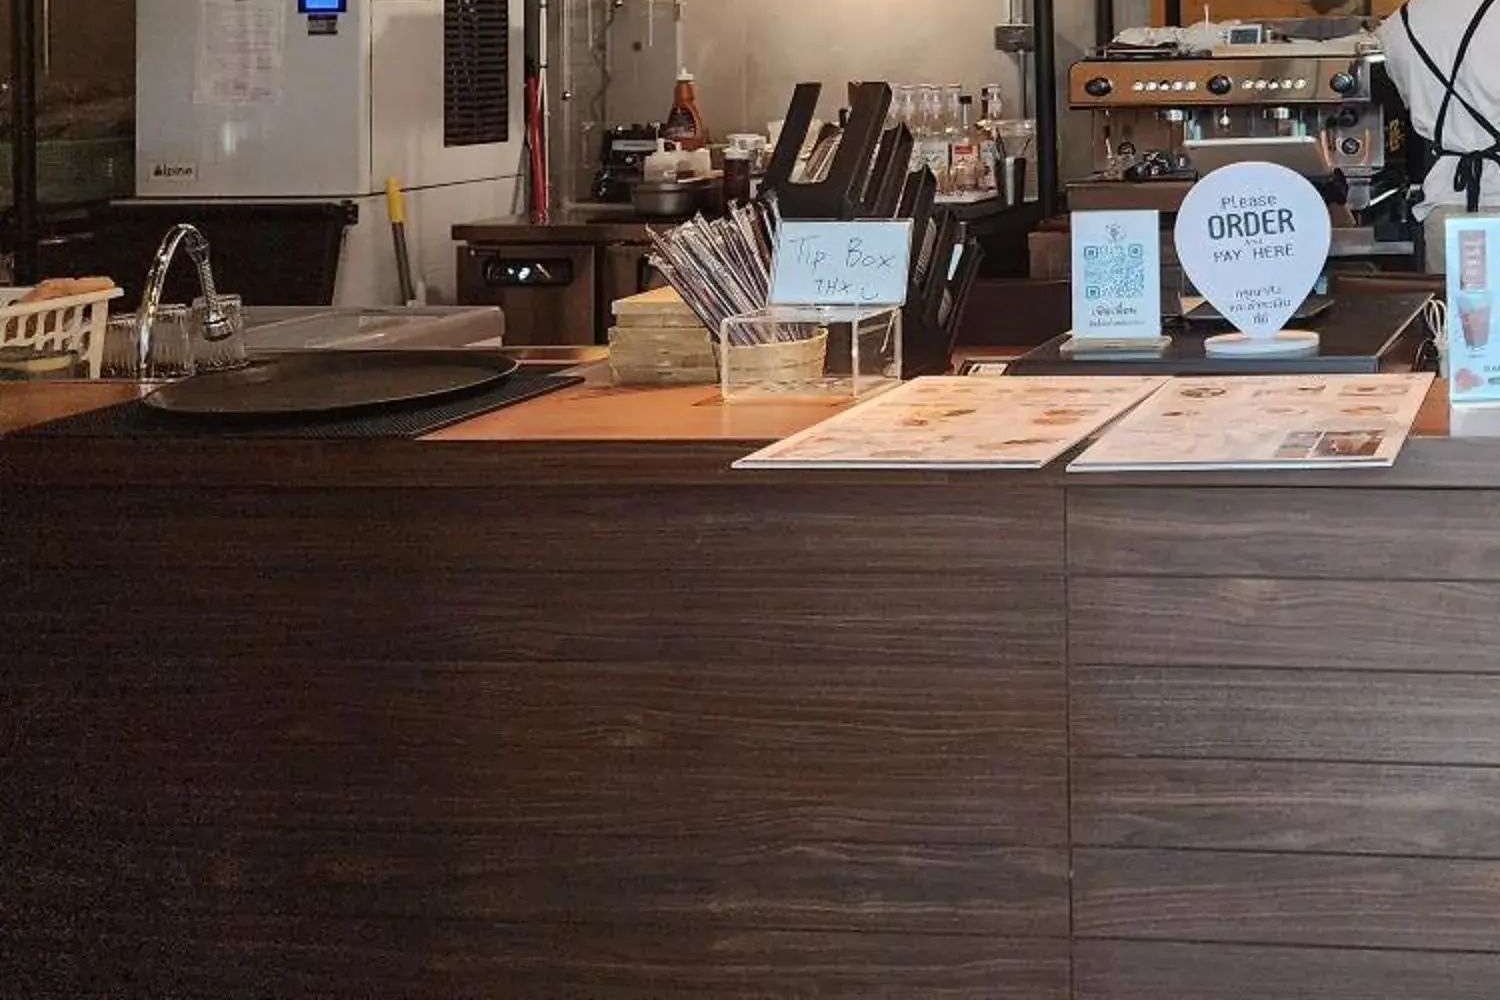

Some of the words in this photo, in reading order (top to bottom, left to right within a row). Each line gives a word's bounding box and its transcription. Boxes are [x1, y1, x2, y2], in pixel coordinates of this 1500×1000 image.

[1208, 209, 1295, 240] ORDER
[845, 237, 896, 268] Box
[1213, 249, 1243, 263] PAY
[1253, 243, 1295, 261] HERE
